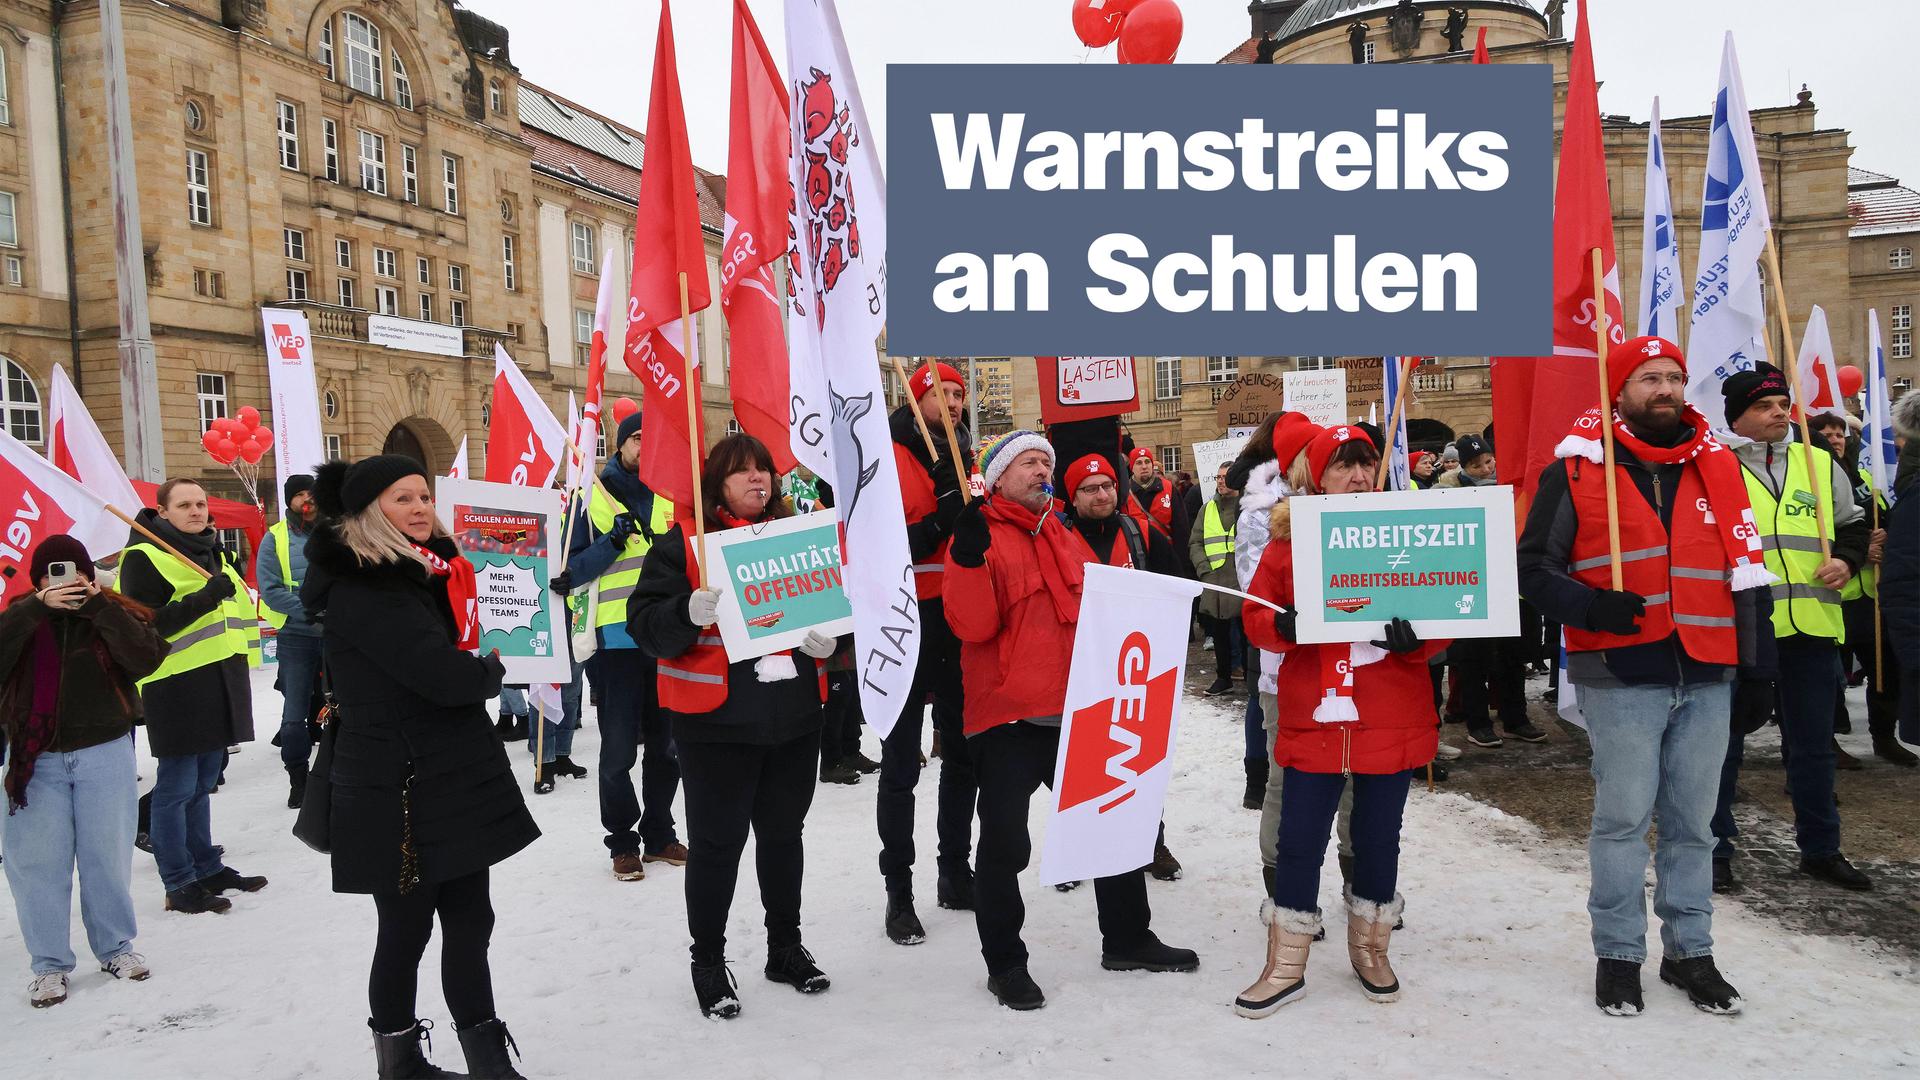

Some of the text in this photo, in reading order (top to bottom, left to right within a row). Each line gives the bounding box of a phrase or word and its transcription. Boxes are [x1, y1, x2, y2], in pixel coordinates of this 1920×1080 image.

[1063, 357, 1127, 384] LASTEN
[1289, 376, 1301, 386] Wir
[1304, 374, 1337, 387] brauchen
[1290, 389, 1334, 401] Lehrer für
[464, 514, 537, 526] SCHULEN AM LIMIT
[1328, 522, 1479, 549] ARBEITSZEIT
[489, 572, 515, 582] MEHR
[1329, 571, 1479, 588] ARBEITSBELASTUNG
[489, 584, 518, 594] MULTI-
[1454, 599, 1475, 608] GEW
[490, 608, 519, 618] TEAMS
[529, 638, 550, 648] GEW
[1098, 631, 1151, 814] GEW
